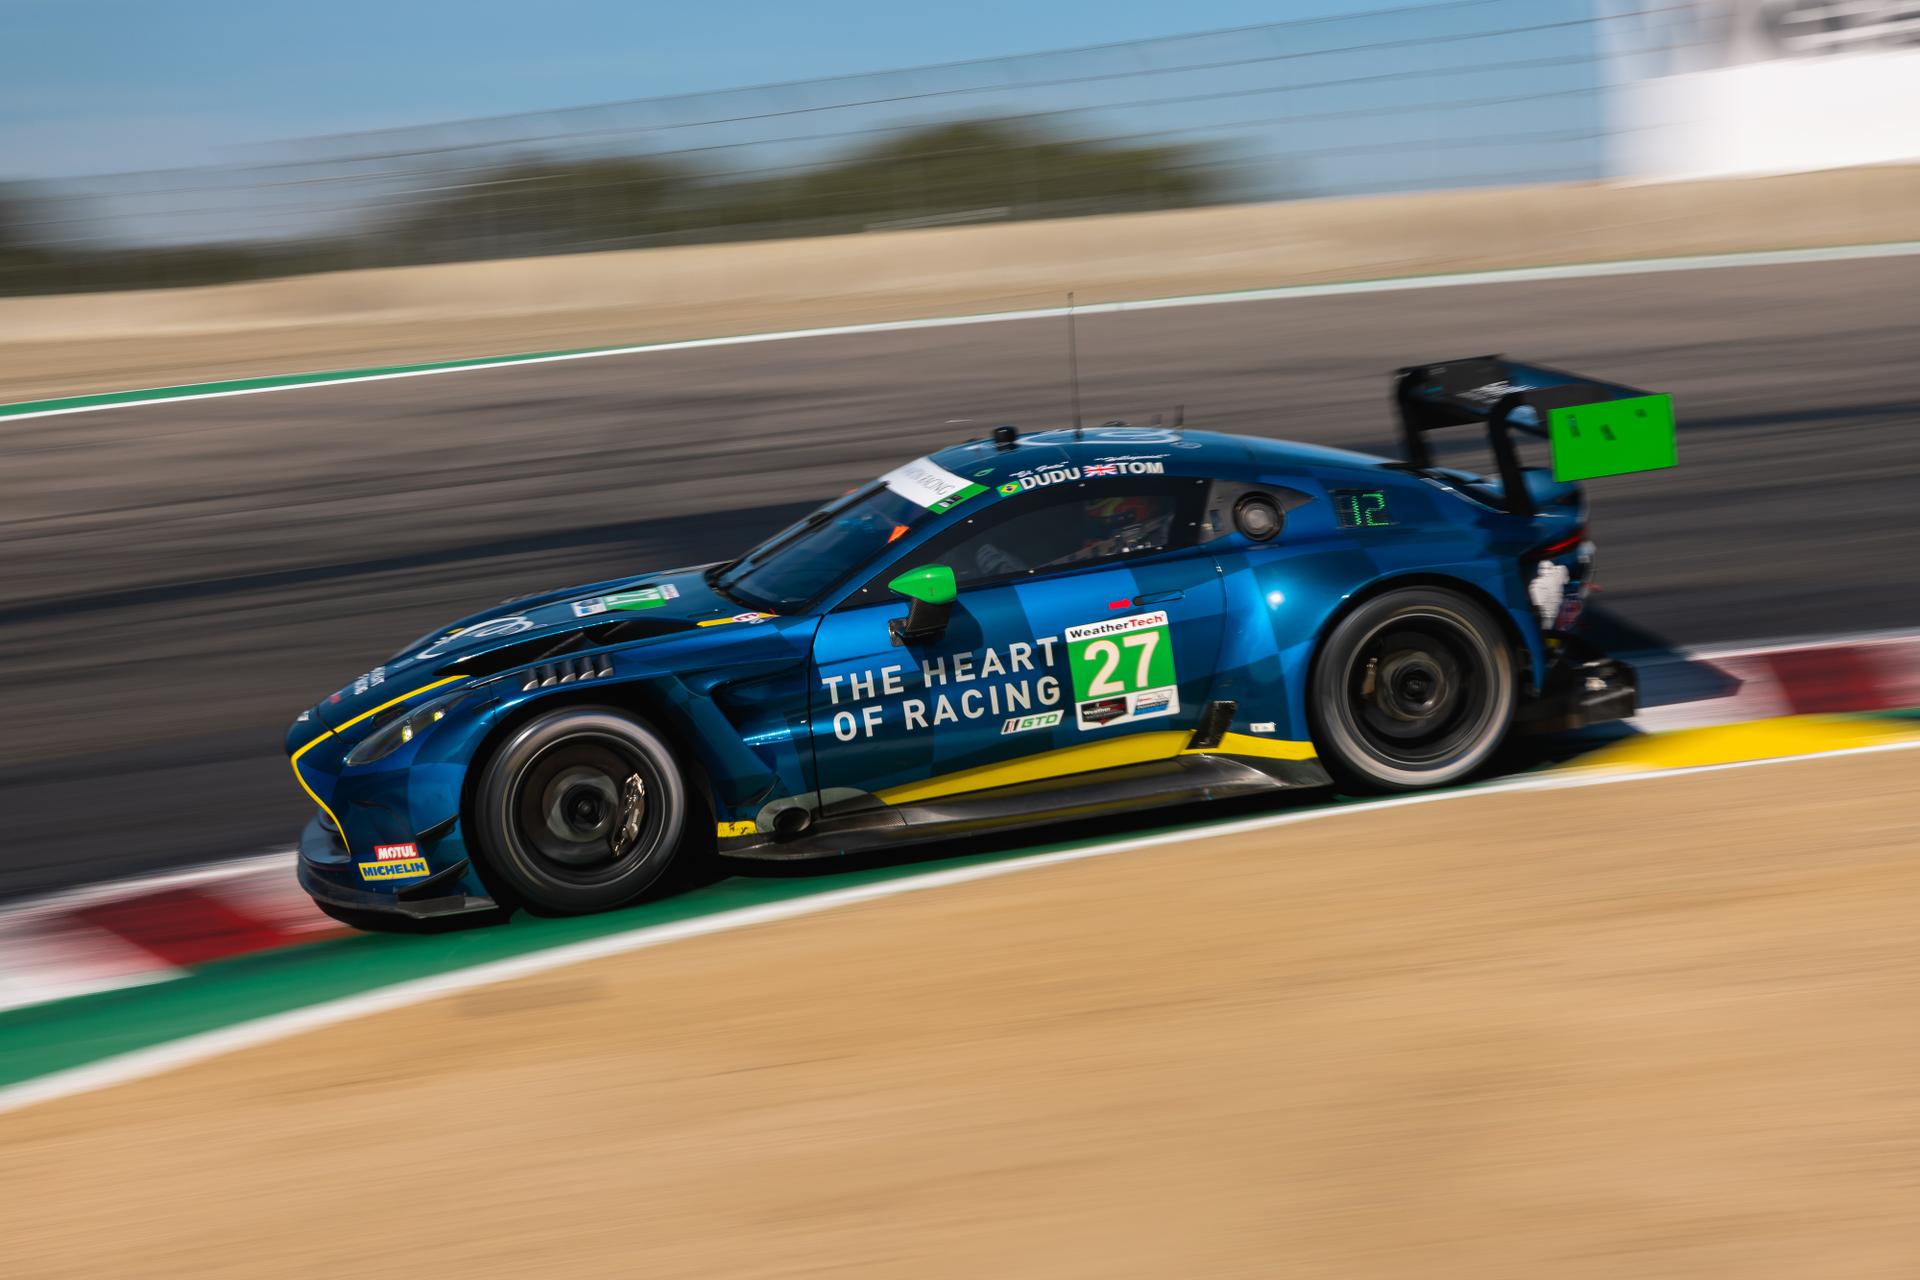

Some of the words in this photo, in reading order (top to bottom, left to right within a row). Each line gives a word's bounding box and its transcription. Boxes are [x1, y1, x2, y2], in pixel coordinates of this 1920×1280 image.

[1019, 467, 1081, 490] DUDU
[1117, 462, 1165, 474] TOM
[1069, 614, 1164, 639] WeatherTech
[822, 664, 905, 706] THE
[922, 636, 1059, 690] HEART
[1084, 631, 1160, 697] 27
[833, 704, 884, 743] OF
[902, 675, 1061, 731] RACING
[377, 845, 417, 860] MOTUL
[362, 862, 426, 877] MICHELIN
